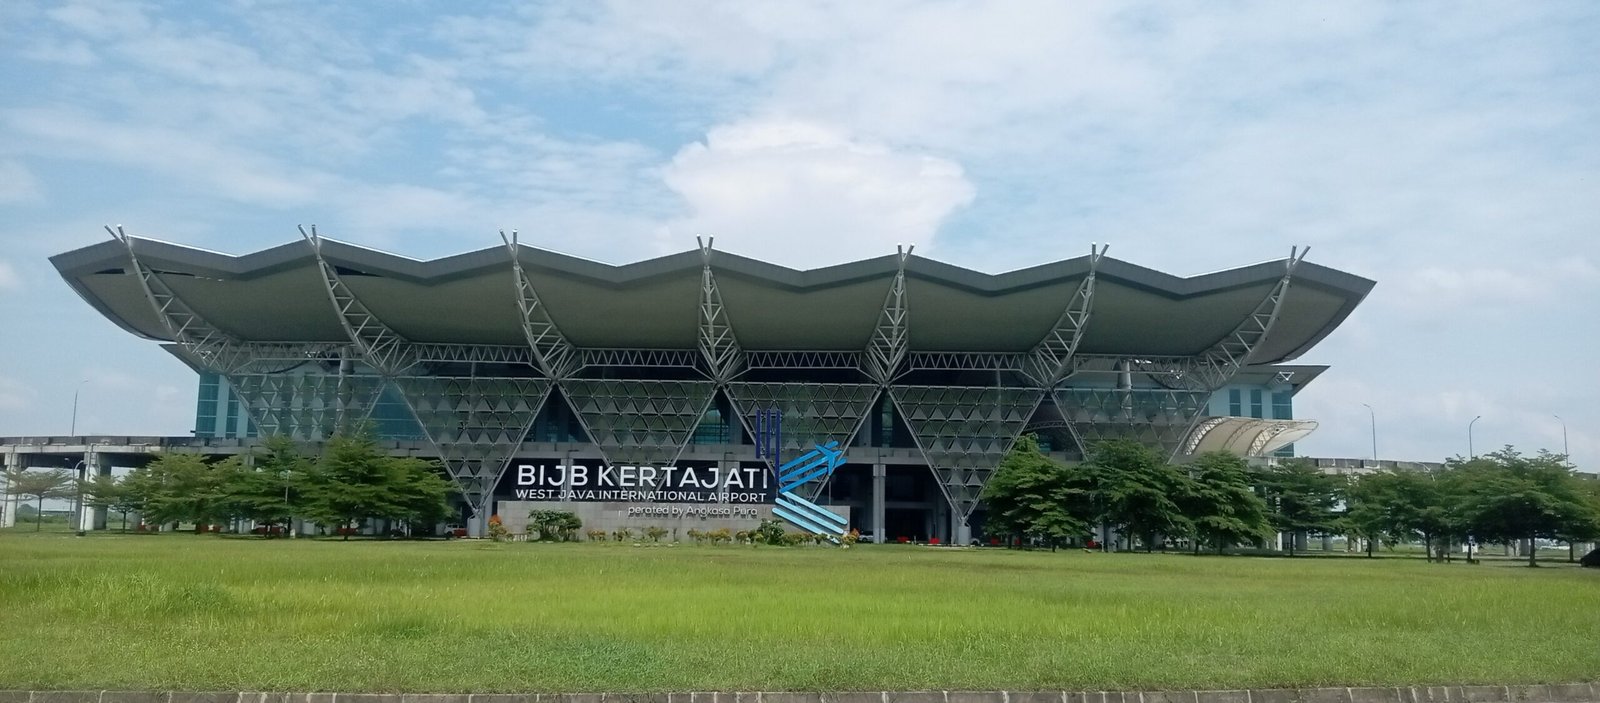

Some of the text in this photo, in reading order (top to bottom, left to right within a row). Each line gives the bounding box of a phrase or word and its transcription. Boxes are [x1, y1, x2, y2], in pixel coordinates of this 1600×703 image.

[518, 465, 768, 489] BIJB KERTAJATI
[516, 489, 767, 503] WEST JAVA INTERNATIONAL AIRPORT
[672, 505, 684, 517] by
[686, 506, 731, 517] Angkasa
[734, 506, 758, 515] Pura
